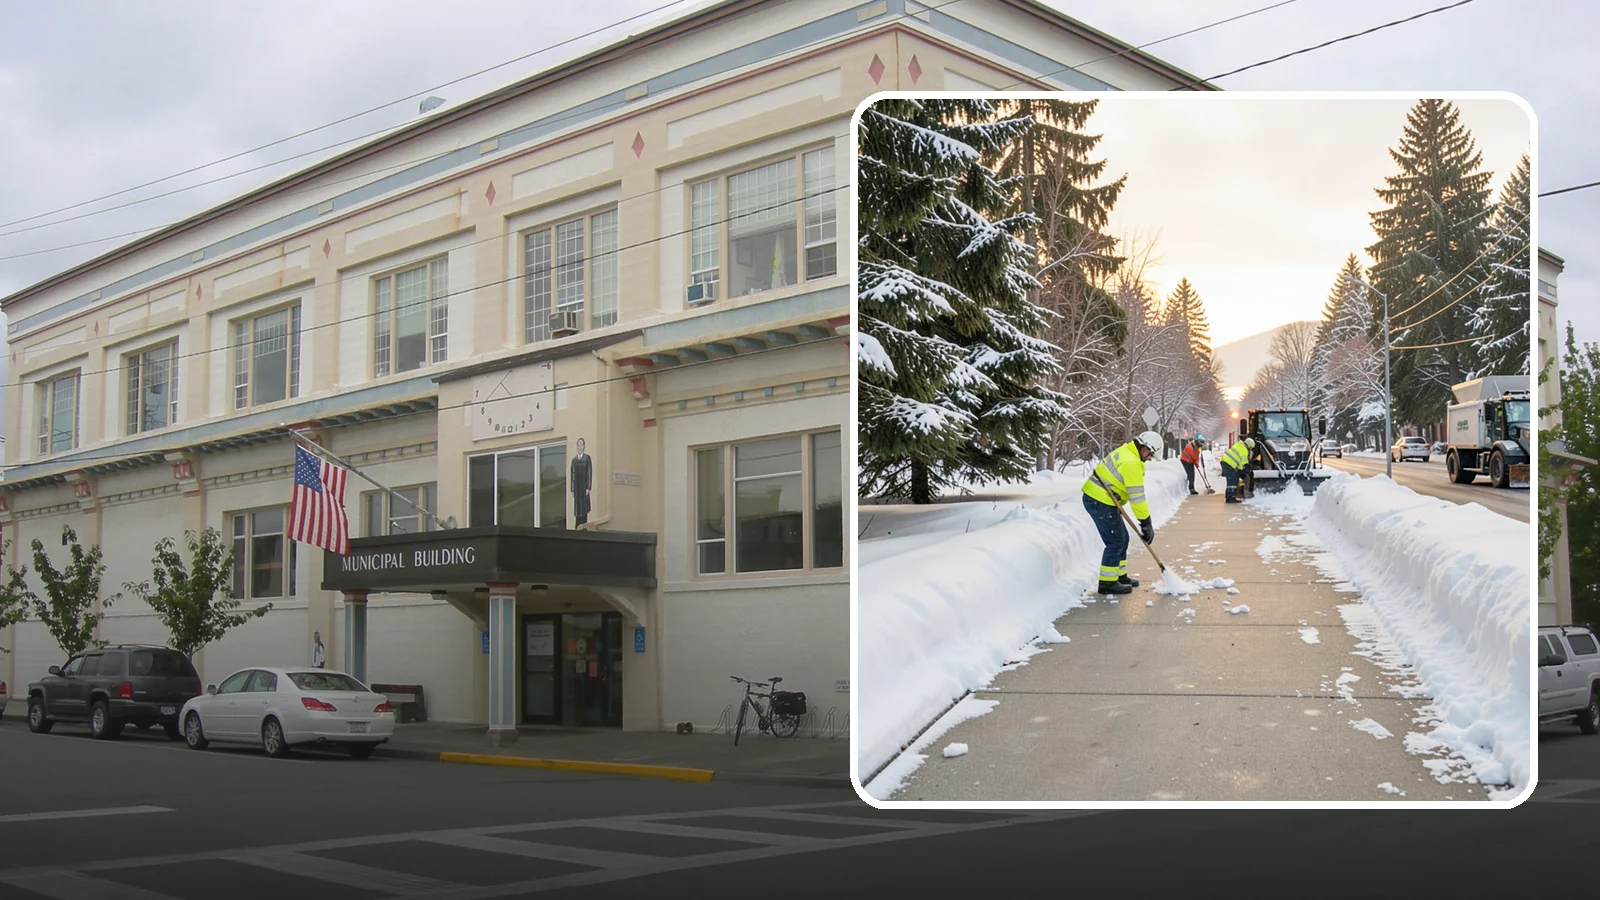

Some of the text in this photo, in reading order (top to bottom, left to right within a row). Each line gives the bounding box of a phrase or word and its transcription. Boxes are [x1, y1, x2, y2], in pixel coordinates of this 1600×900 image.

[507, 425, 513, 433] 12
[342, 546, 475, 572] MUNICIPAL BUILDING
